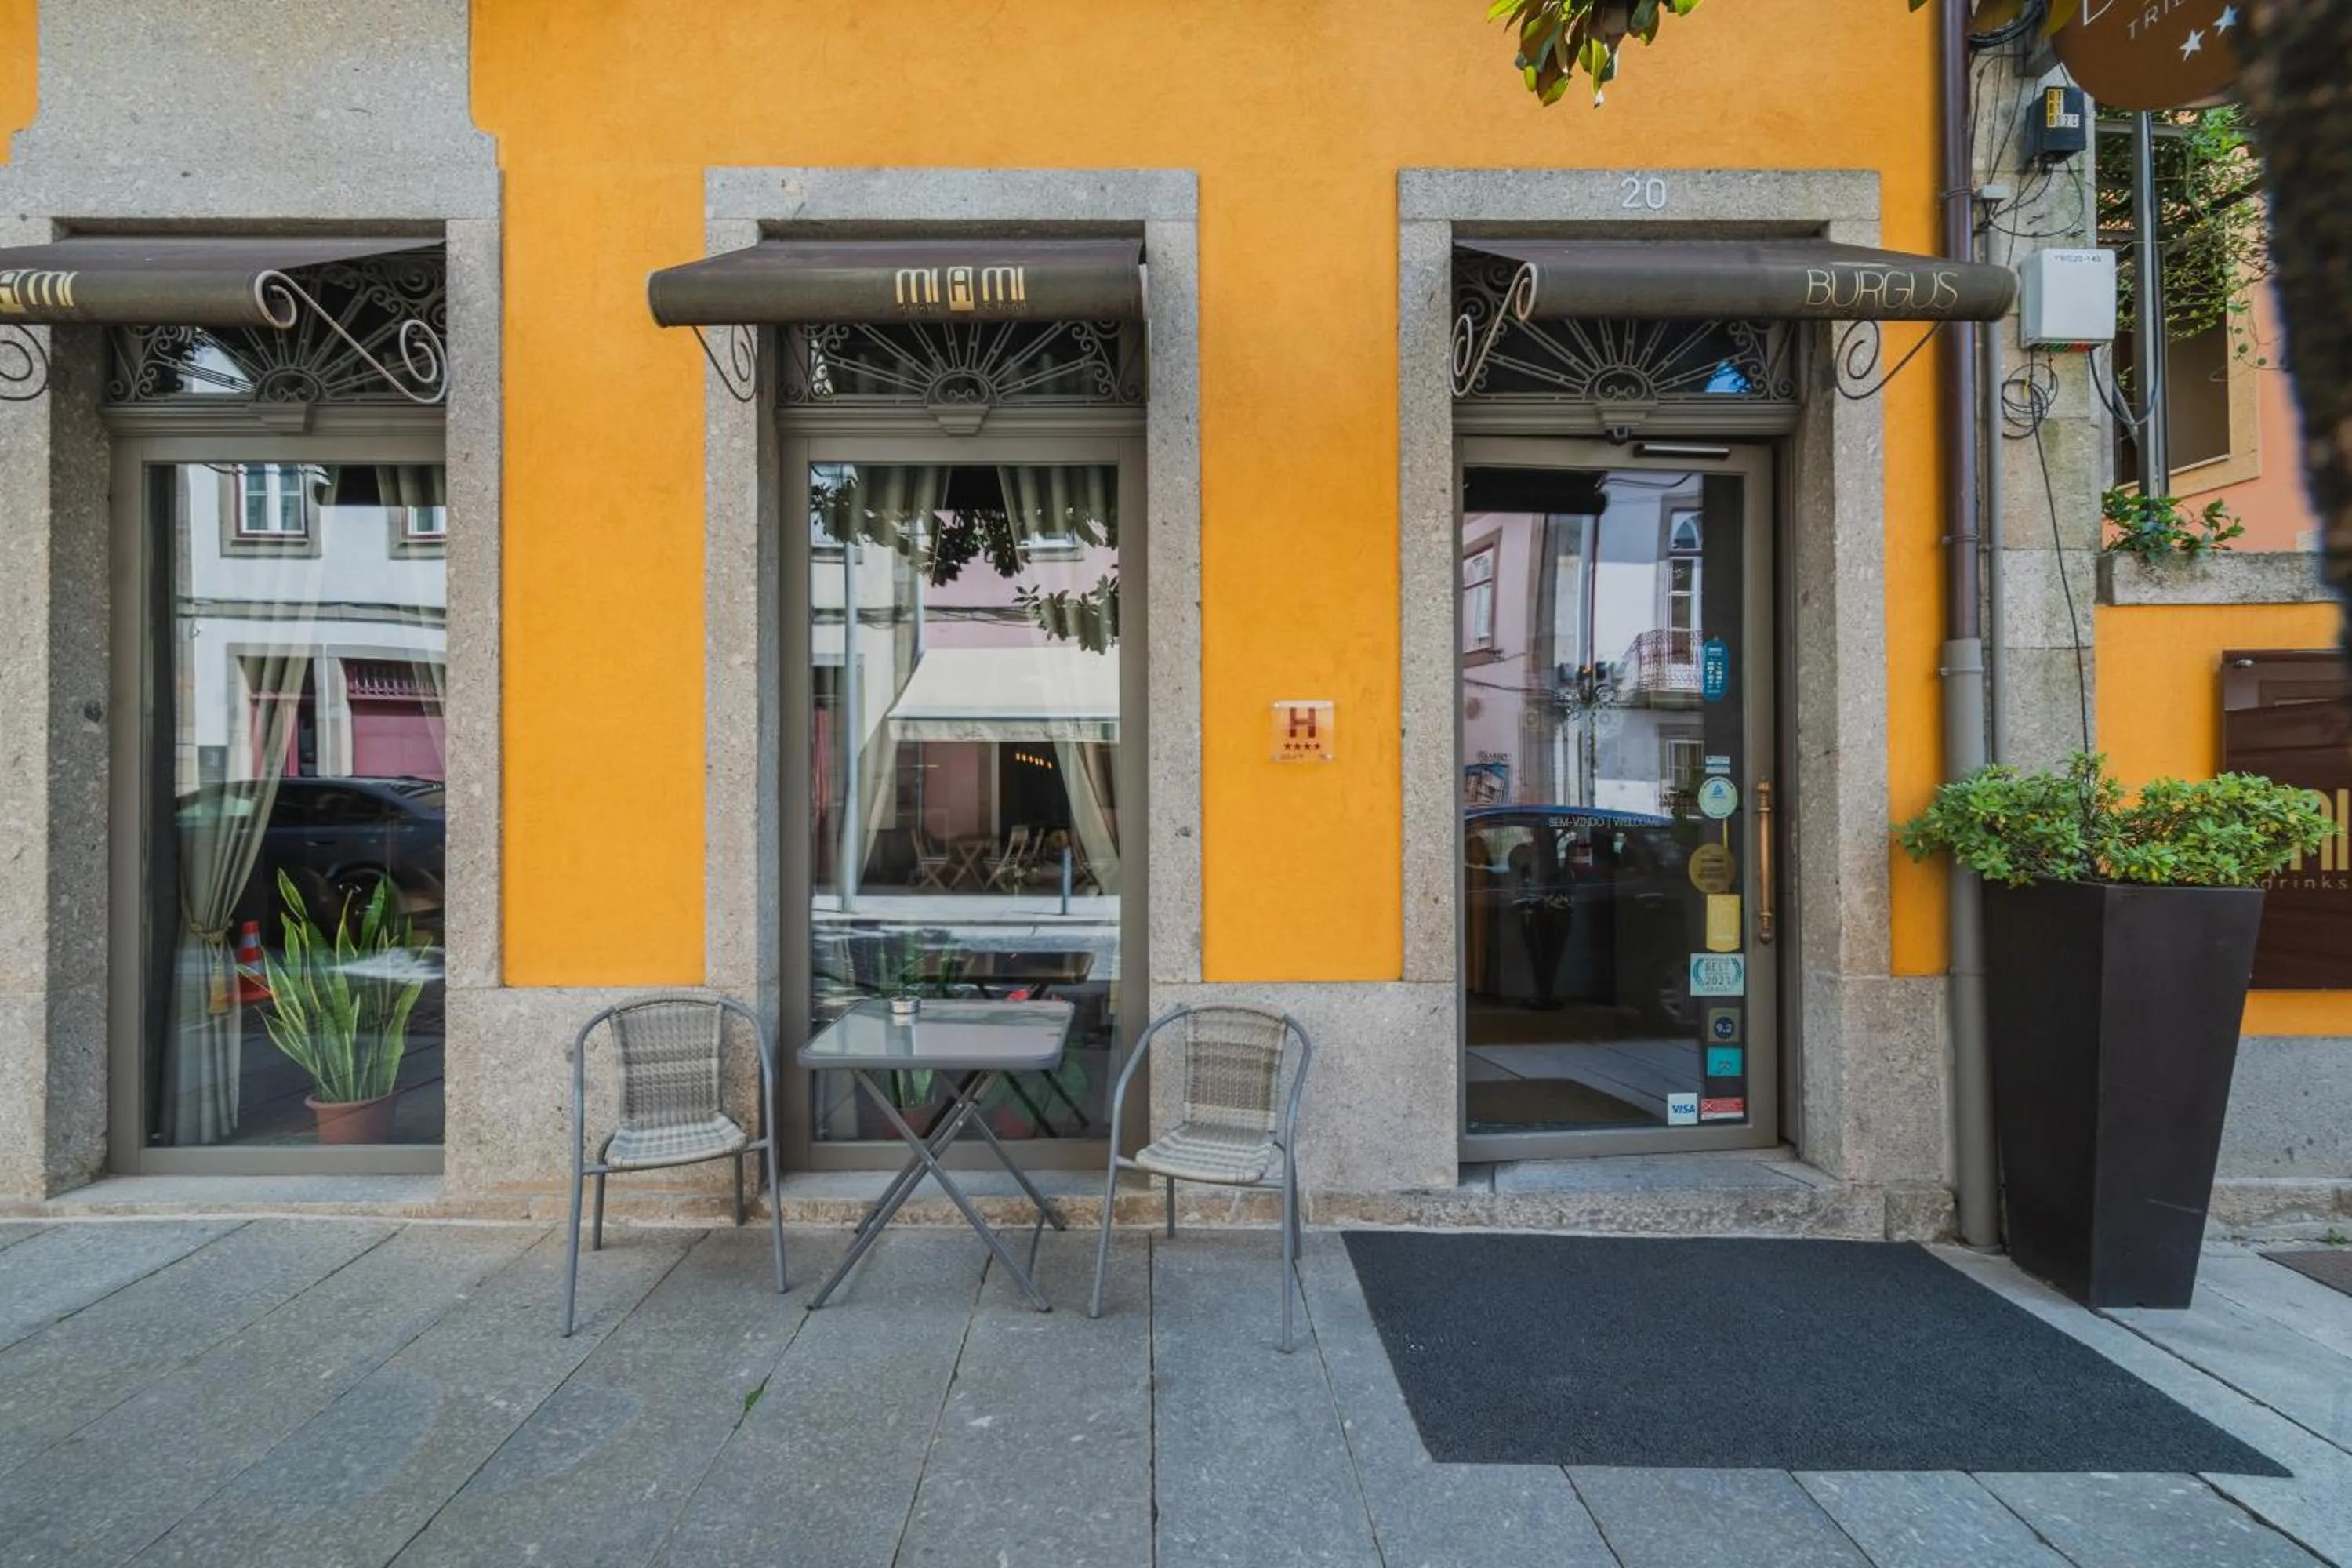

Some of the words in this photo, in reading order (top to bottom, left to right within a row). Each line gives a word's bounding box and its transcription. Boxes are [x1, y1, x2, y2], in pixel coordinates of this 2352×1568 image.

[1621, 177, 1666, 209] 20
[1806, 269, 1958, 309] BURGUS
[1289, 706, 1316, 738] H
[2260, 873, 2349, 891] drinks
[1671, 1103, 1697, 1115] VISA
